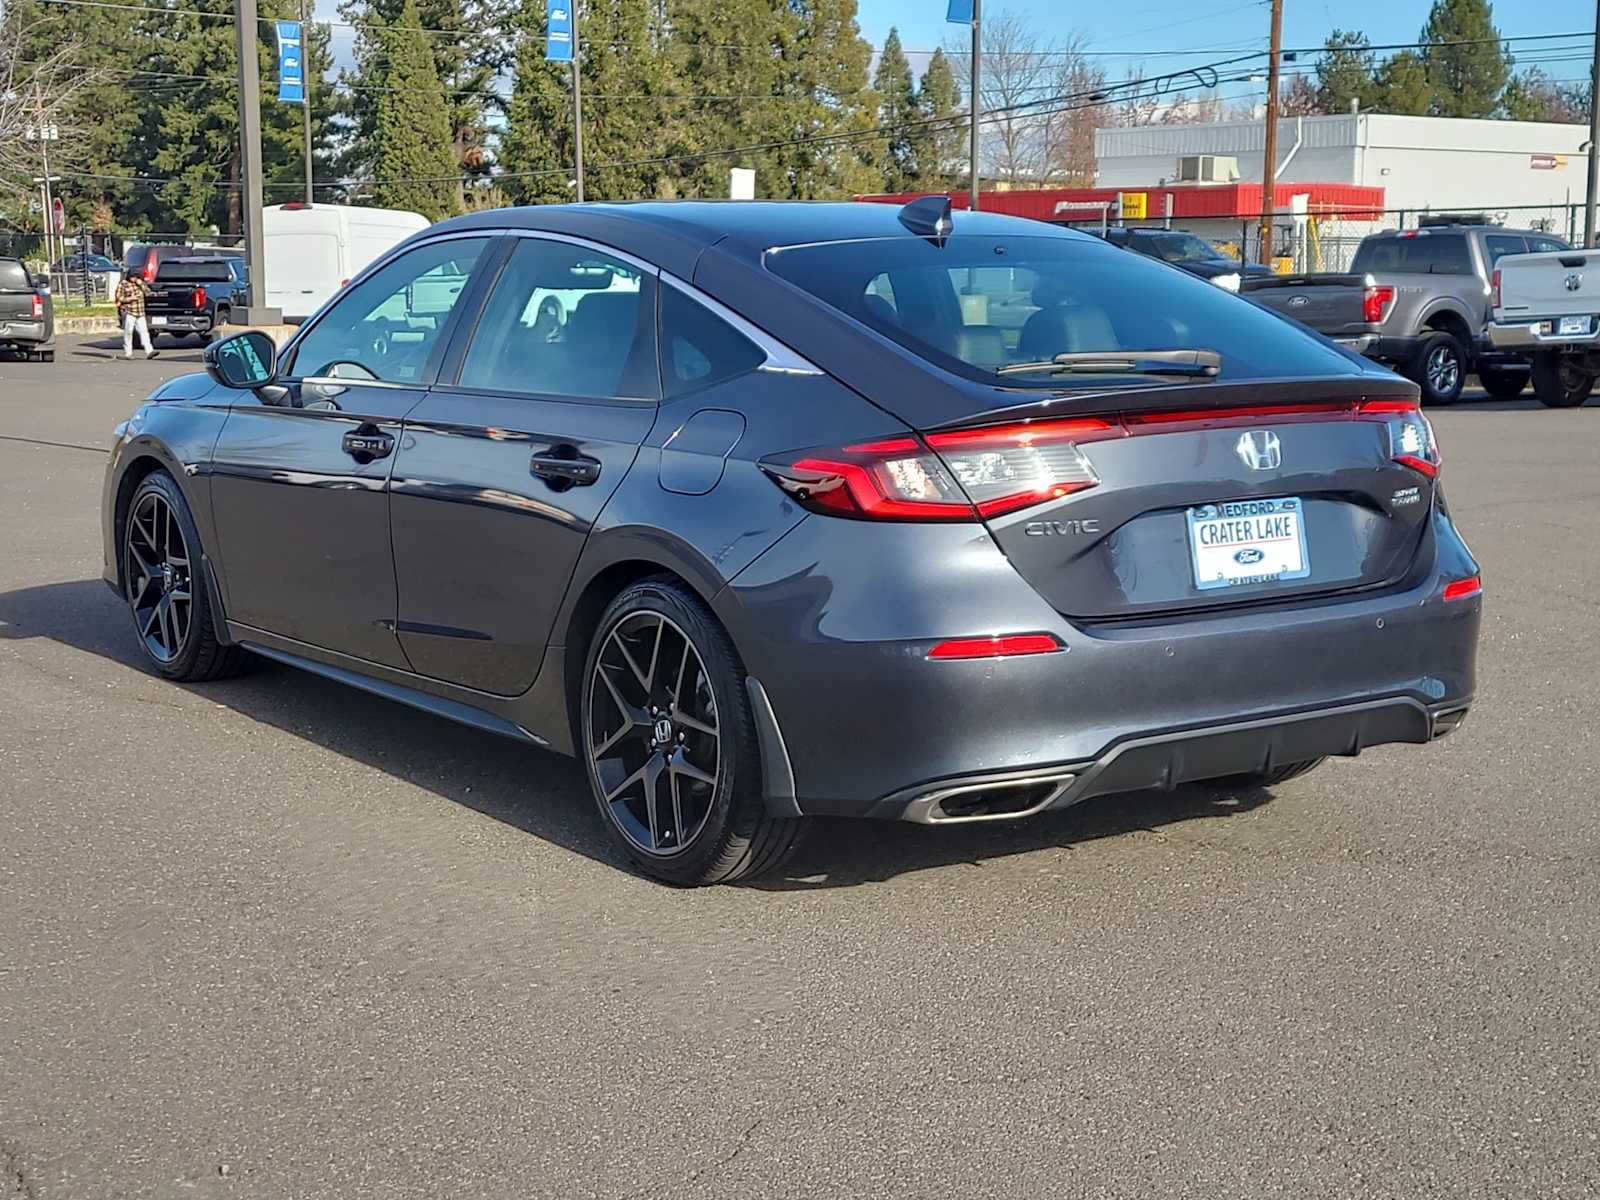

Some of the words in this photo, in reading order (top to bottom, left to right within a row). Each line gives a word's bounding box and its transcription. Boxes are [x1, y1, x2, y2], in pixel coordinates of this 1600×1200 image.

[1025, 519, 1100, 536] CIVIC
[1200, 520, 1254, 545] CRATER
[1256, 516, 1292, 540] LAKE
